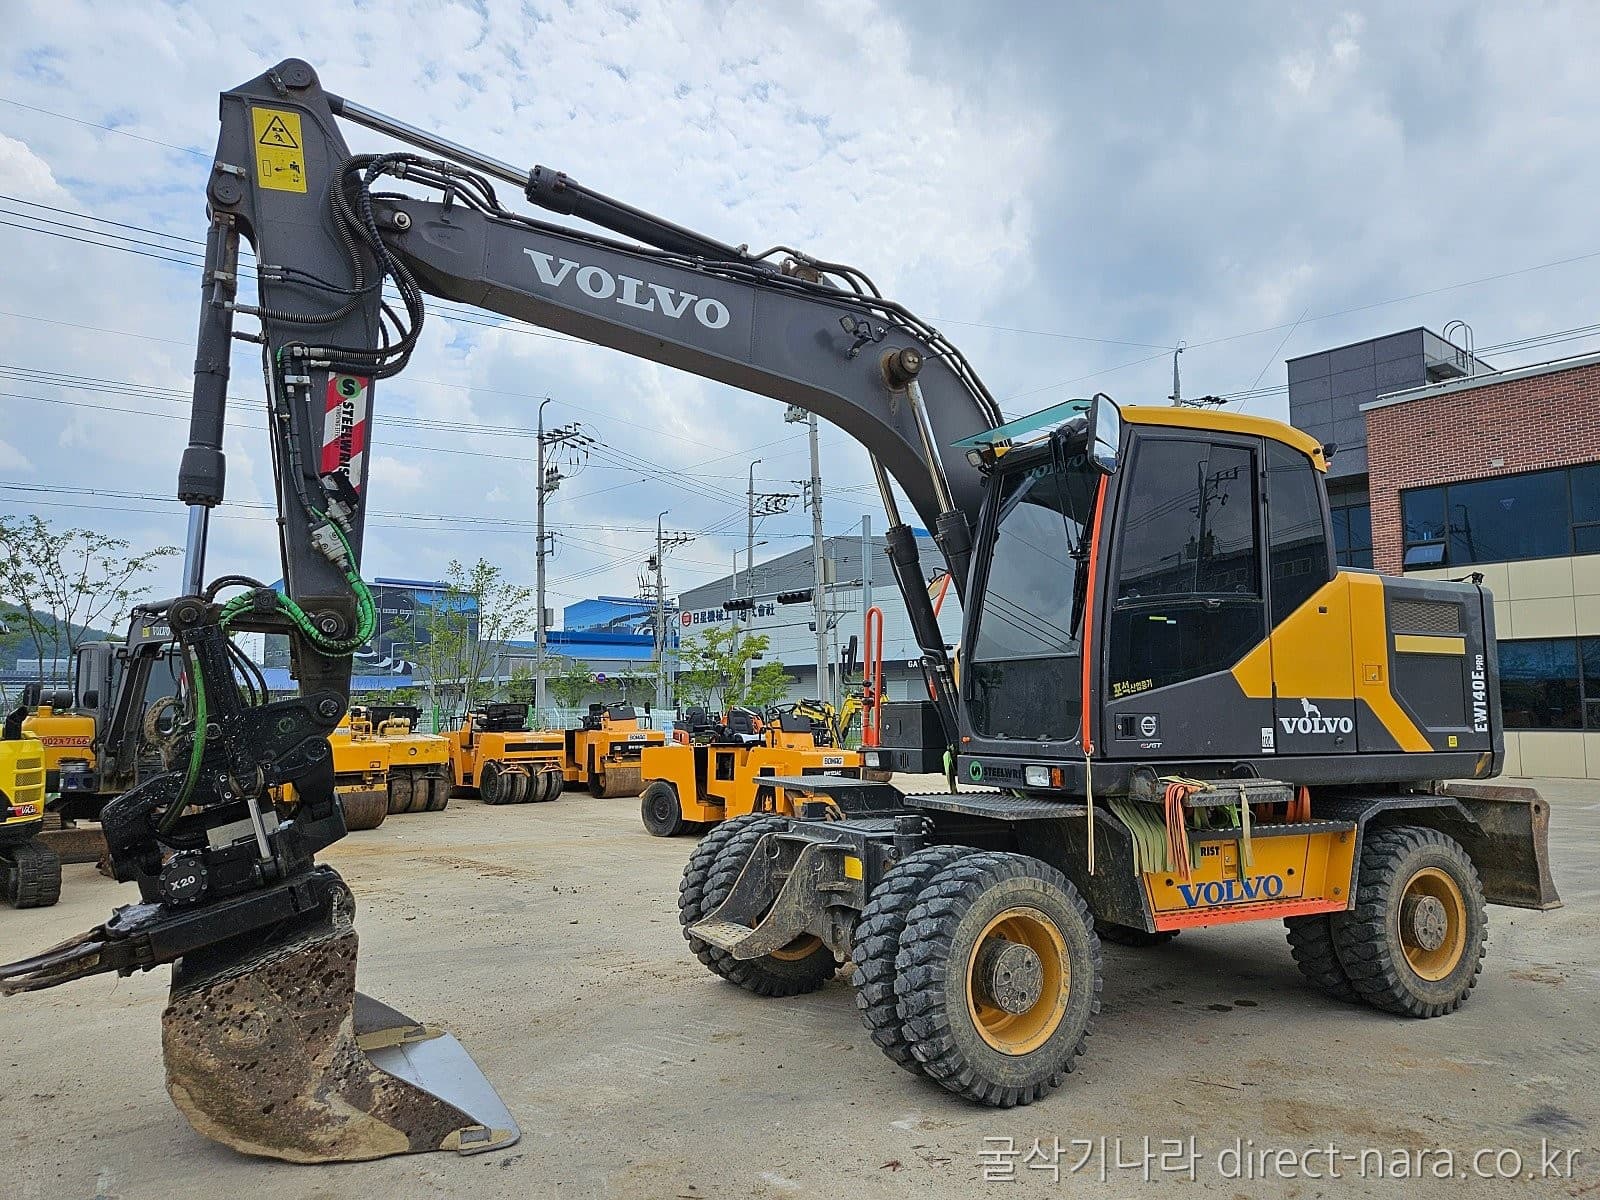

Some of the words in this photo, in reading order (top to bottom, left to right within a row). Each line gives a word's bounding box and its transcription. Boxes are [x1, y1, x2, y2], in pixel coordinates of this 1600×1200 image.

[524, 247, 731, 329] VOLVO
[907, 659, 928, 668] GAE
[1475, 654, 1484, 671] PRO
[1471, 671, 1488, 732] EW140E
[1279, 717, 1353, 734] VOLVO
[170, 875, 196, 891] X20
[1176, 874, 1284, 909] VOLVO
